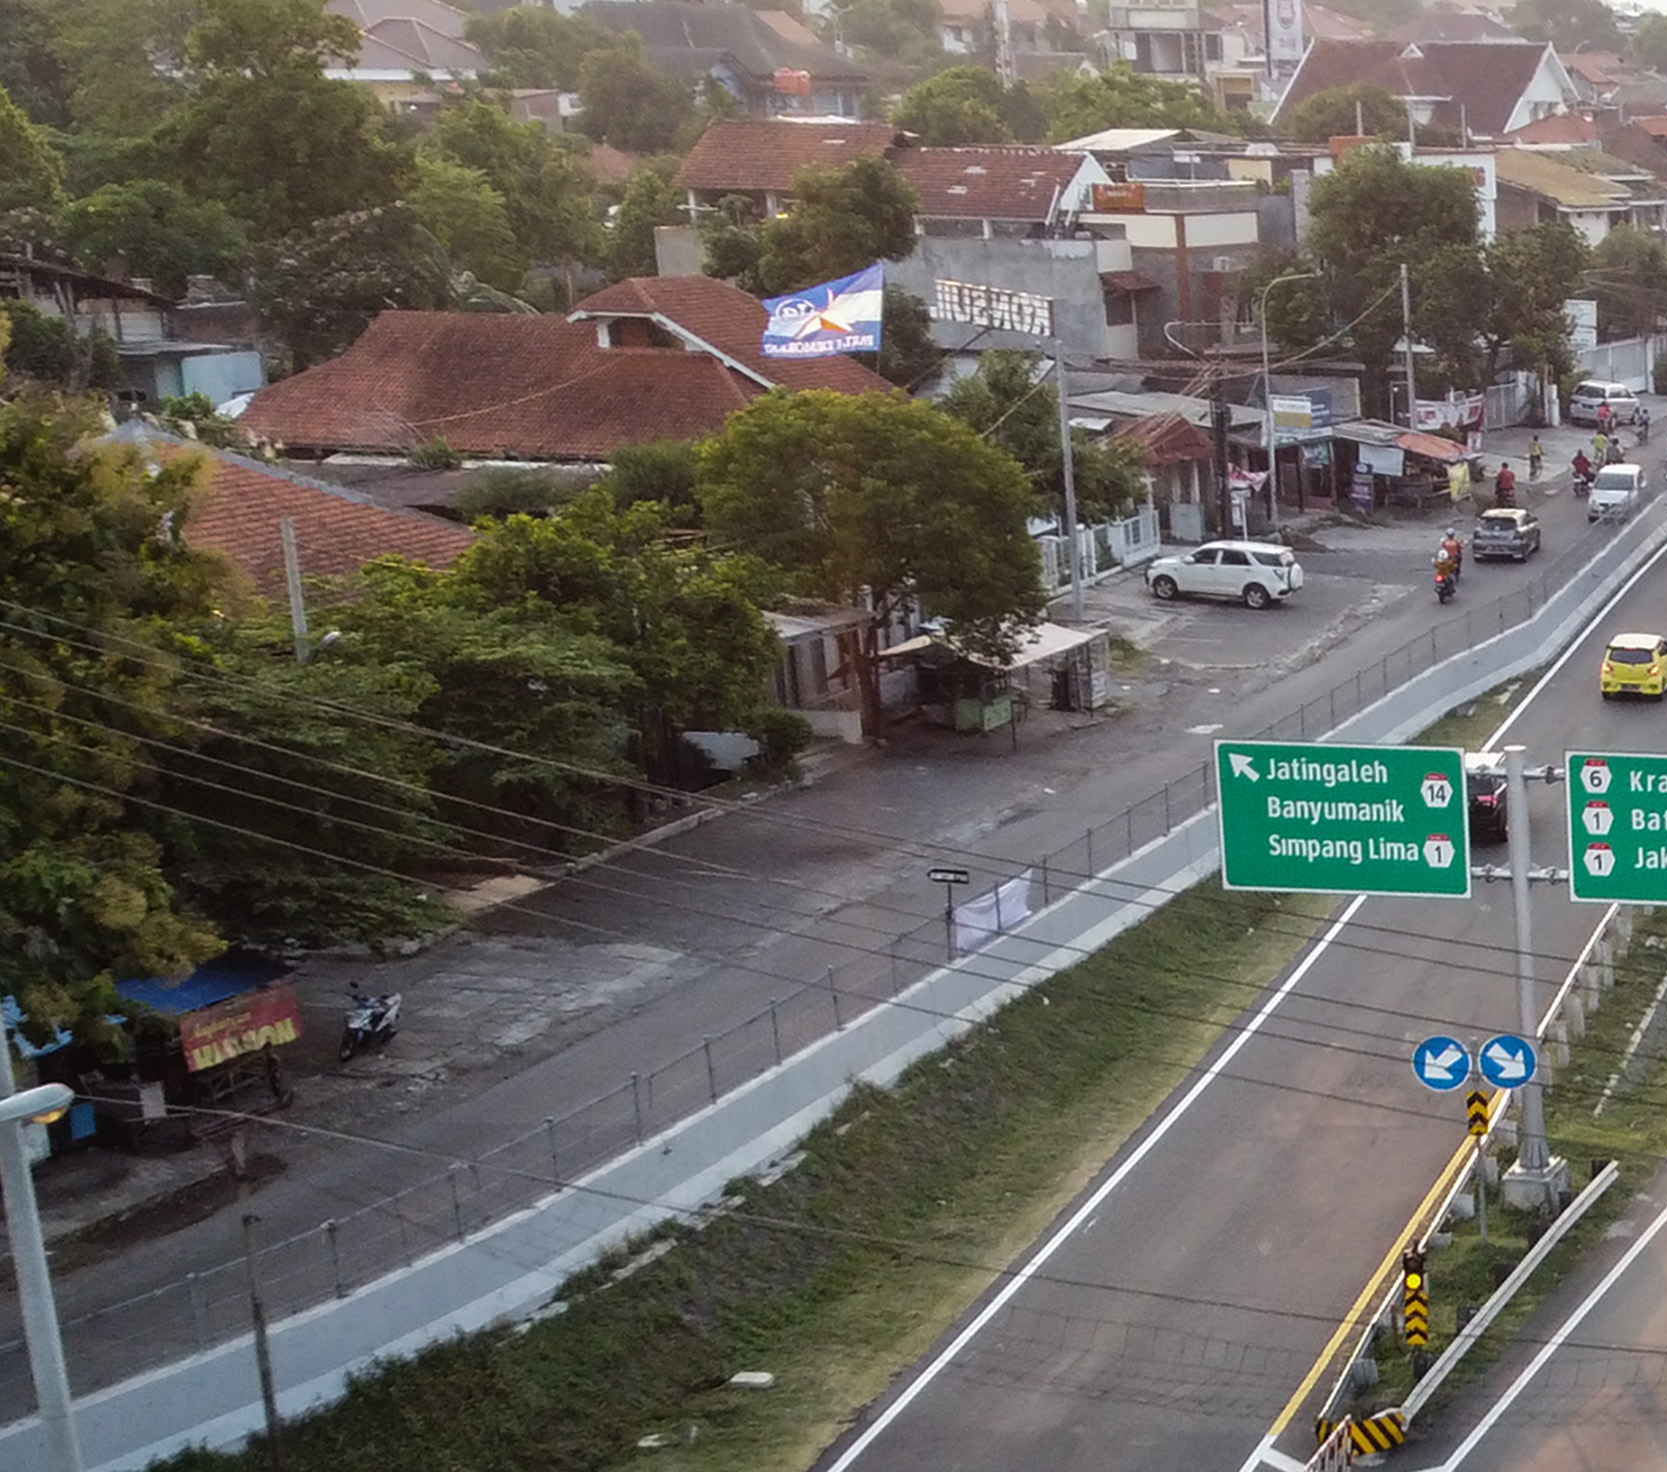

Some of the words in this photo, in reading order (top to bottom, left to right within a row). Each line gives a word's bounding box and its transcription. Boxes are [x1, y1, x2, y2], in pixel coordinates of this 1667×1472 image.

[1266, 757, 1388, 788] Jatingaleh
[1589, 770, 1603, 788] 6
[1427, 783, 1447, 803] 14
[1267, 796, 1404, 825] Banyumanik
[1592, 811, 1600, 831] 1
[1269, 833, 1363, 865] Simpang
[1368, 837, 1420, 861] Lima
[1434, 845, 1443, 865] 1
[1593, 853, 1602, 871] 1
